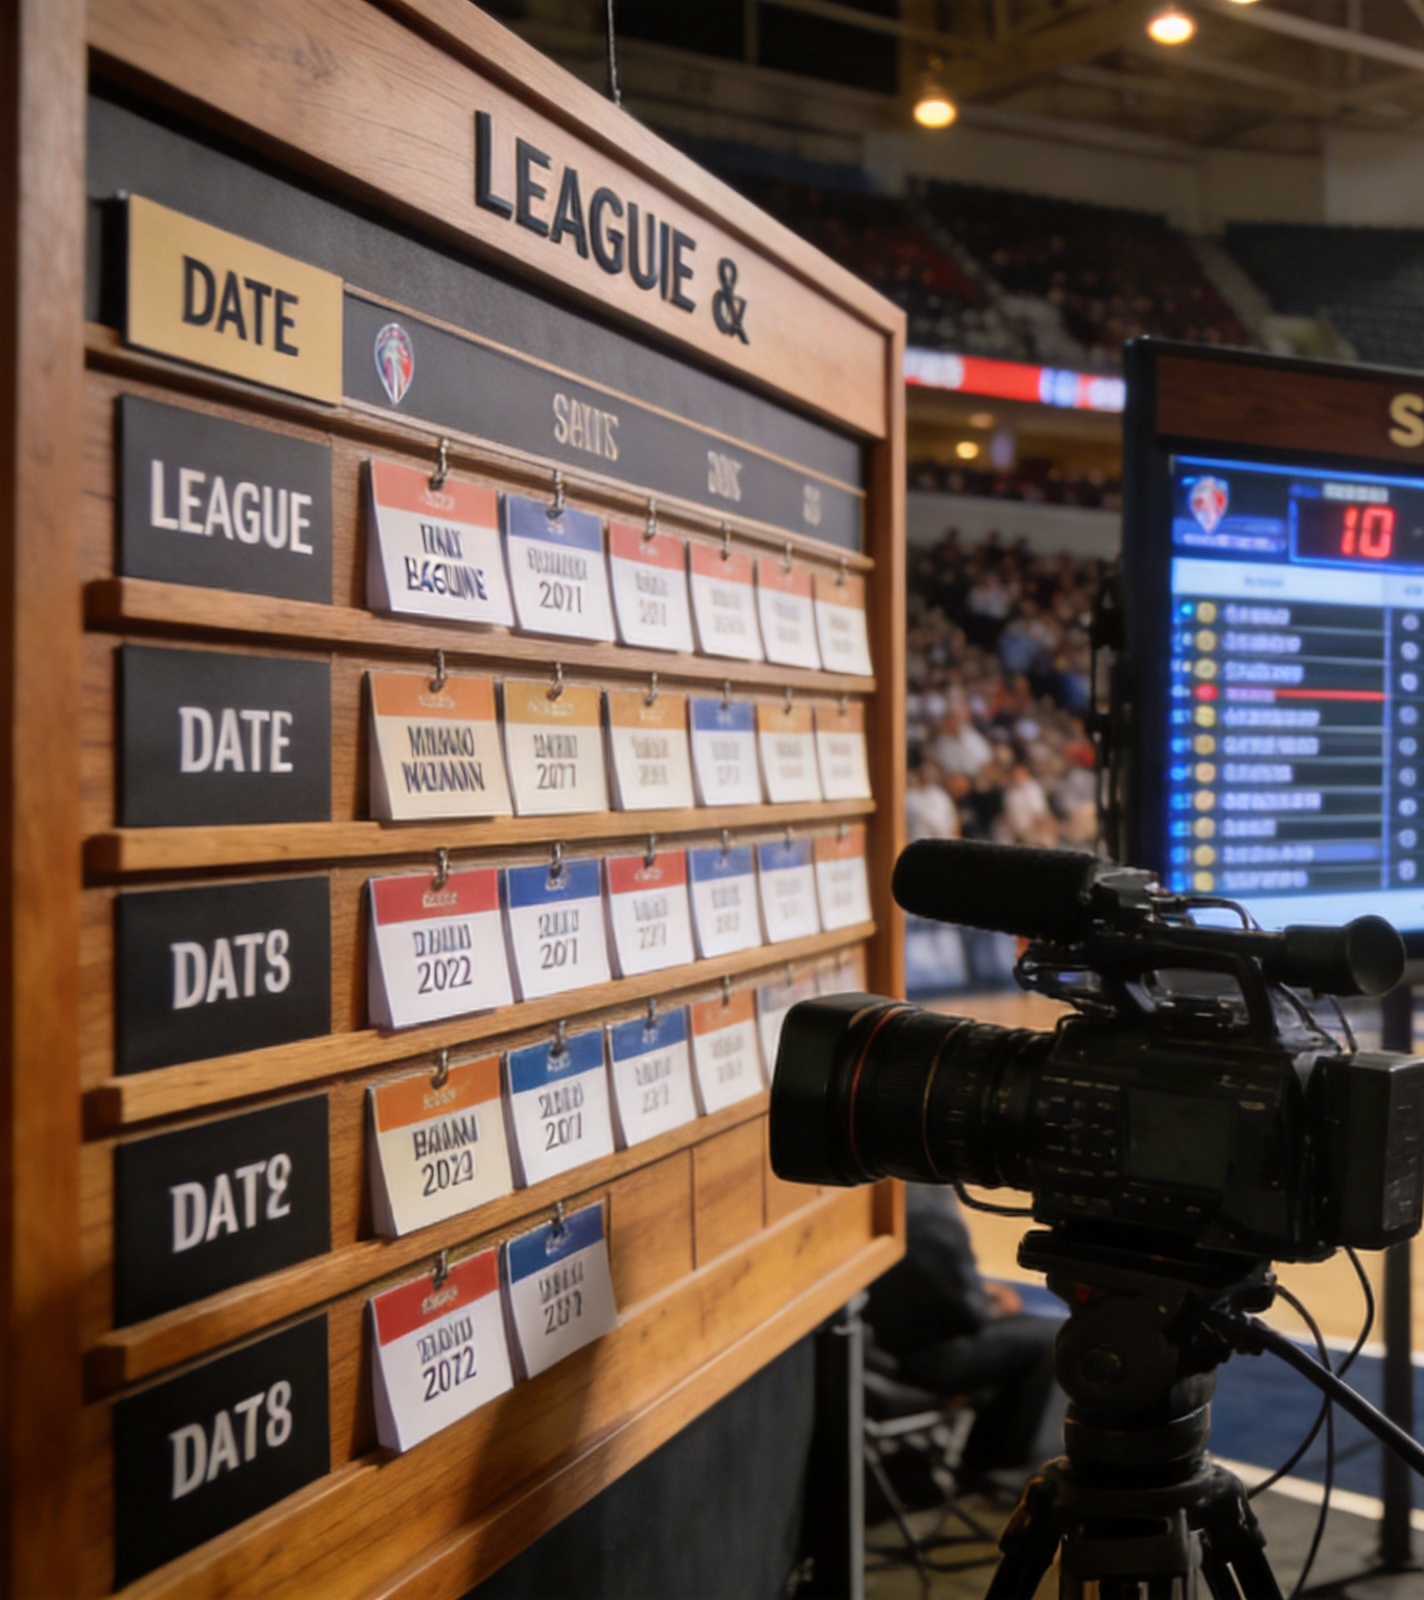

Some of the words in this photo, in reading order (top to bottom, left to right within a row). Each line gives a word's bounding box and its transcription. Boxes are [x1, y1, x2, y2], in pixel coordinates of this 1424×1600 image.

[182, 254, 299, 357] DATE
[712, 257, 750, 345] &
[149, 460, 313, 556] LEAGUE
[1341, 506, 1395, 559] 10
[178, 706, 293, 773] DATE
[168, 1380, 292, 1500] DAT8
